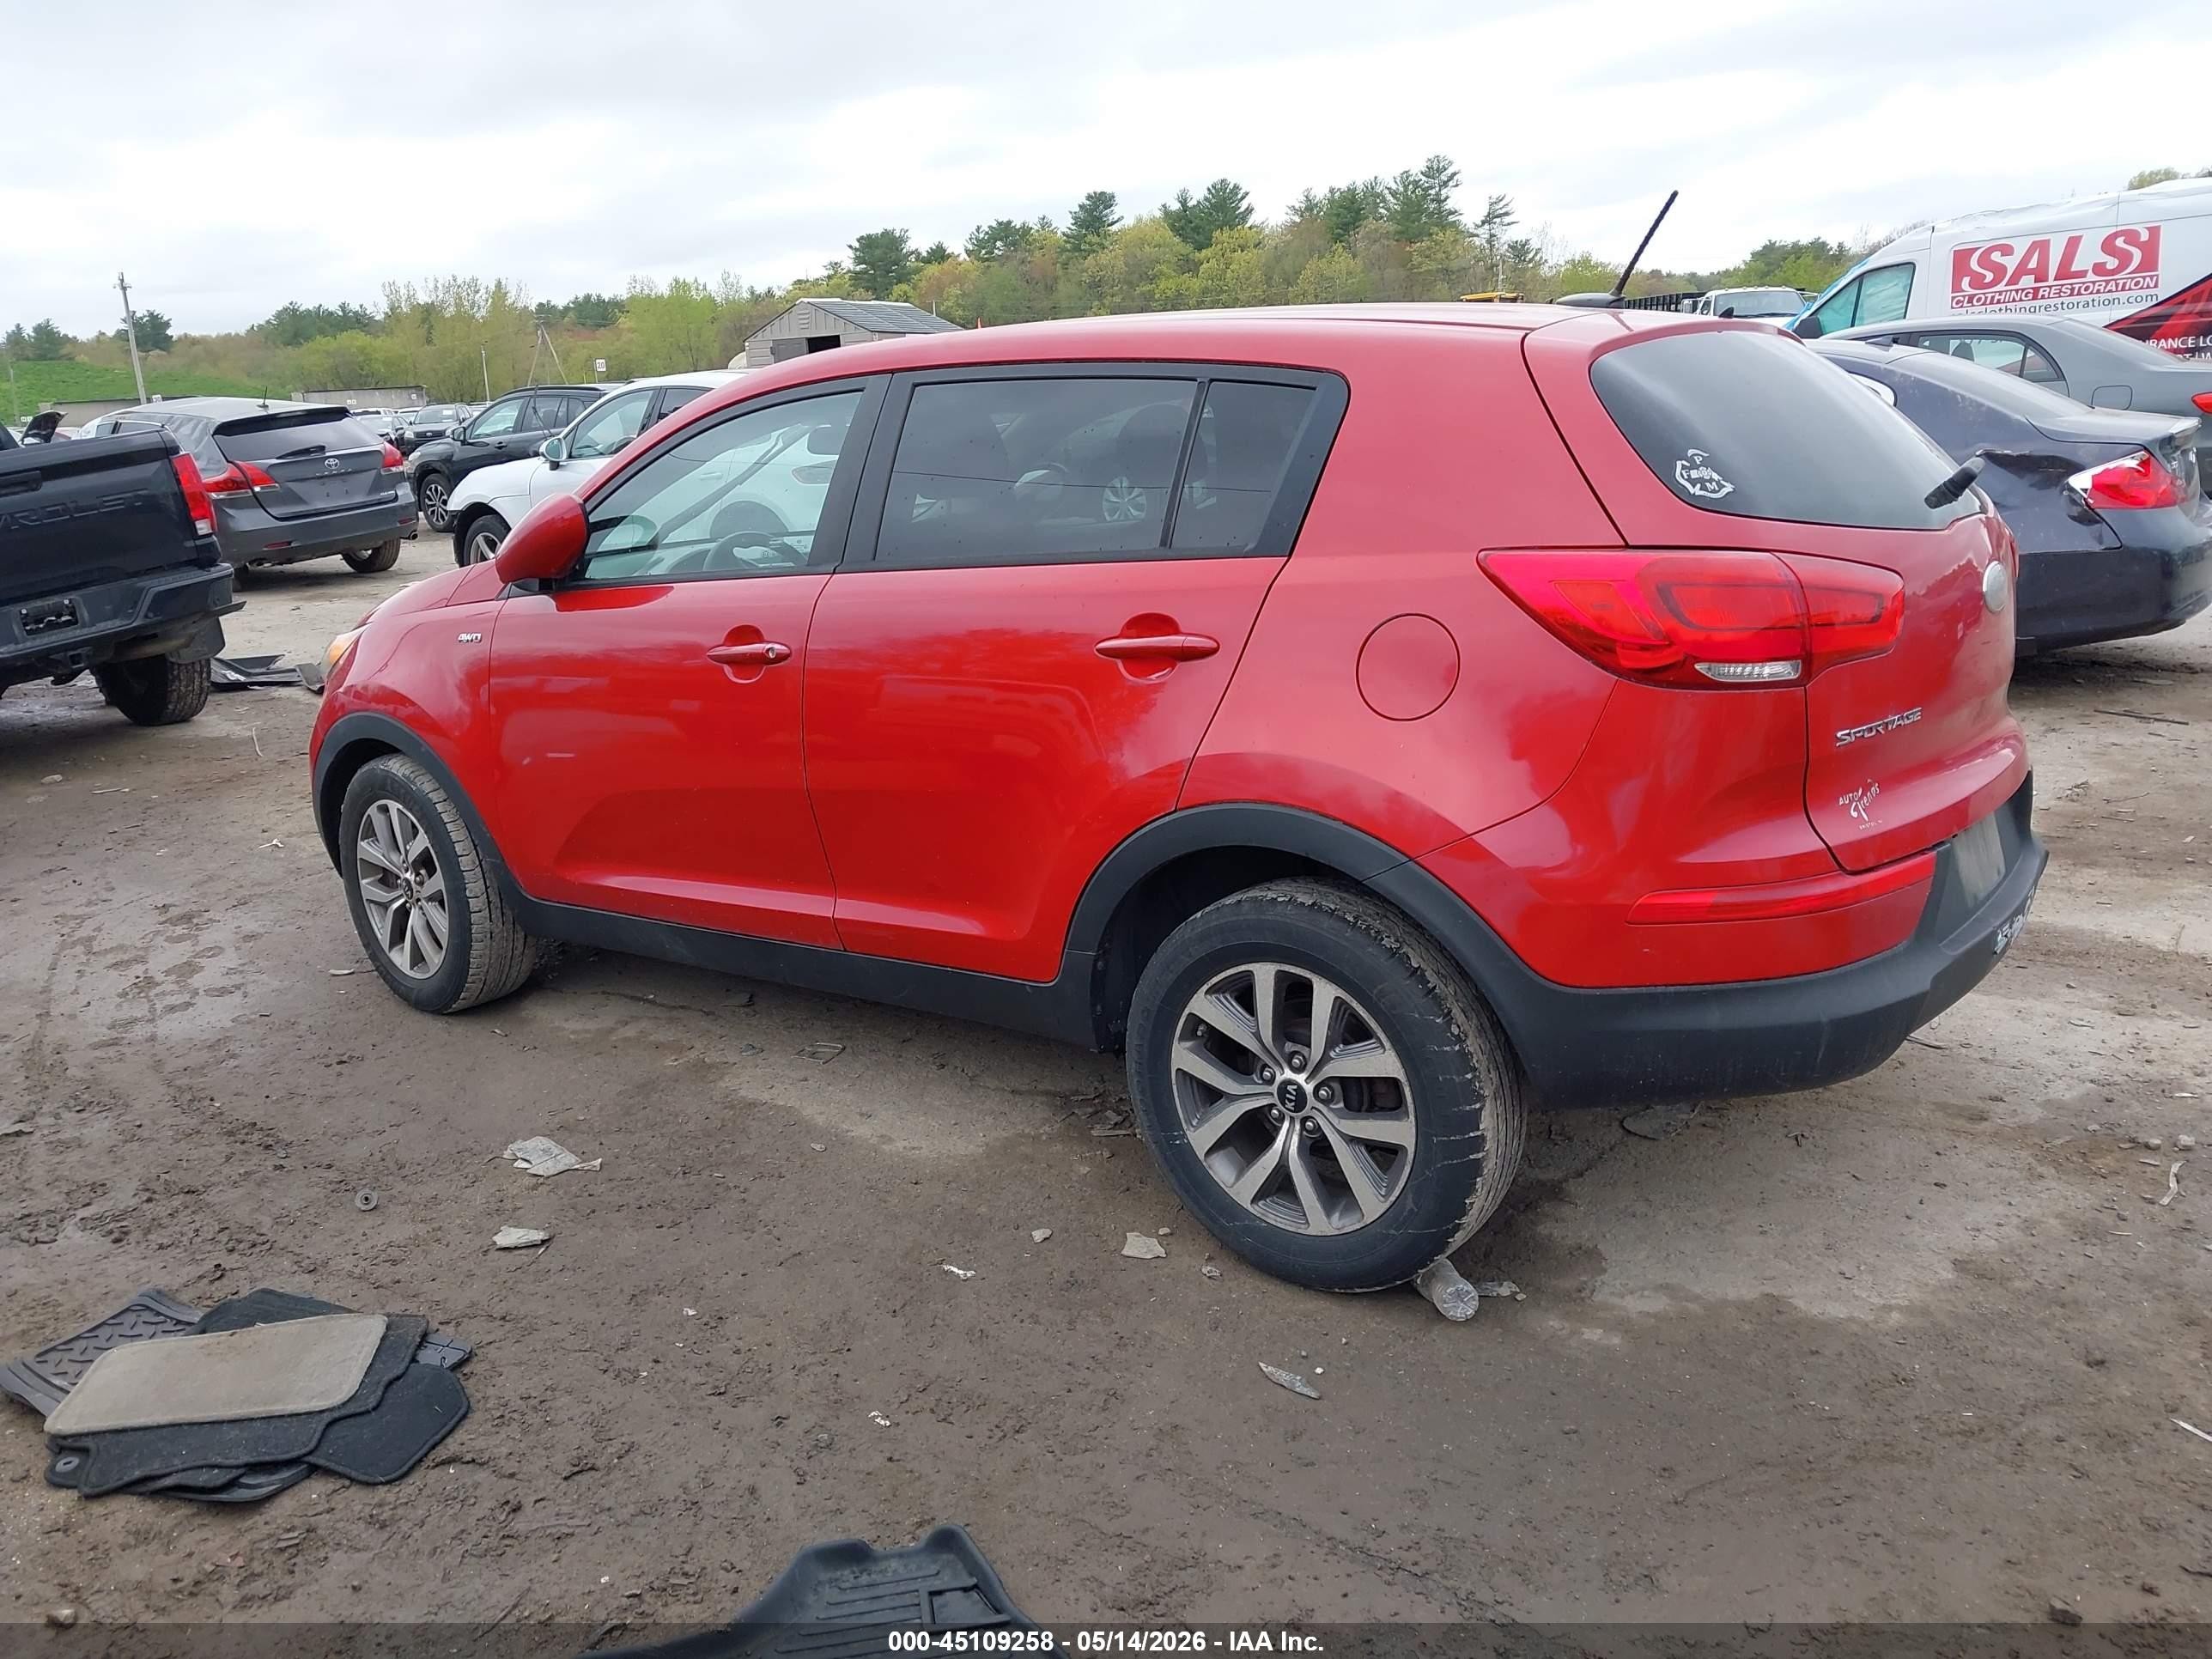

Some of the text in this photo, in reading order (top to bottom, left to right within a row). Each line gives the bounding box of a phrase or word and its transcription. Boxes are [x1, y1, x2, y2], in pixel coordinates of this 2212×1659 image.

[1954, 226, 2157, 293] SALS
[1952, 276, 2158, 308] CLOTHING RESTORATION
[1952, 293, 2159, 315] llothingrestoration.com
[458, 633, 482, 642] 4WD
[1836, 707, 1923, 747] SPORTAGE
[1839, 792, 1859, 805] AUTO
[1285, 1085, 1297, 1110] KIA
